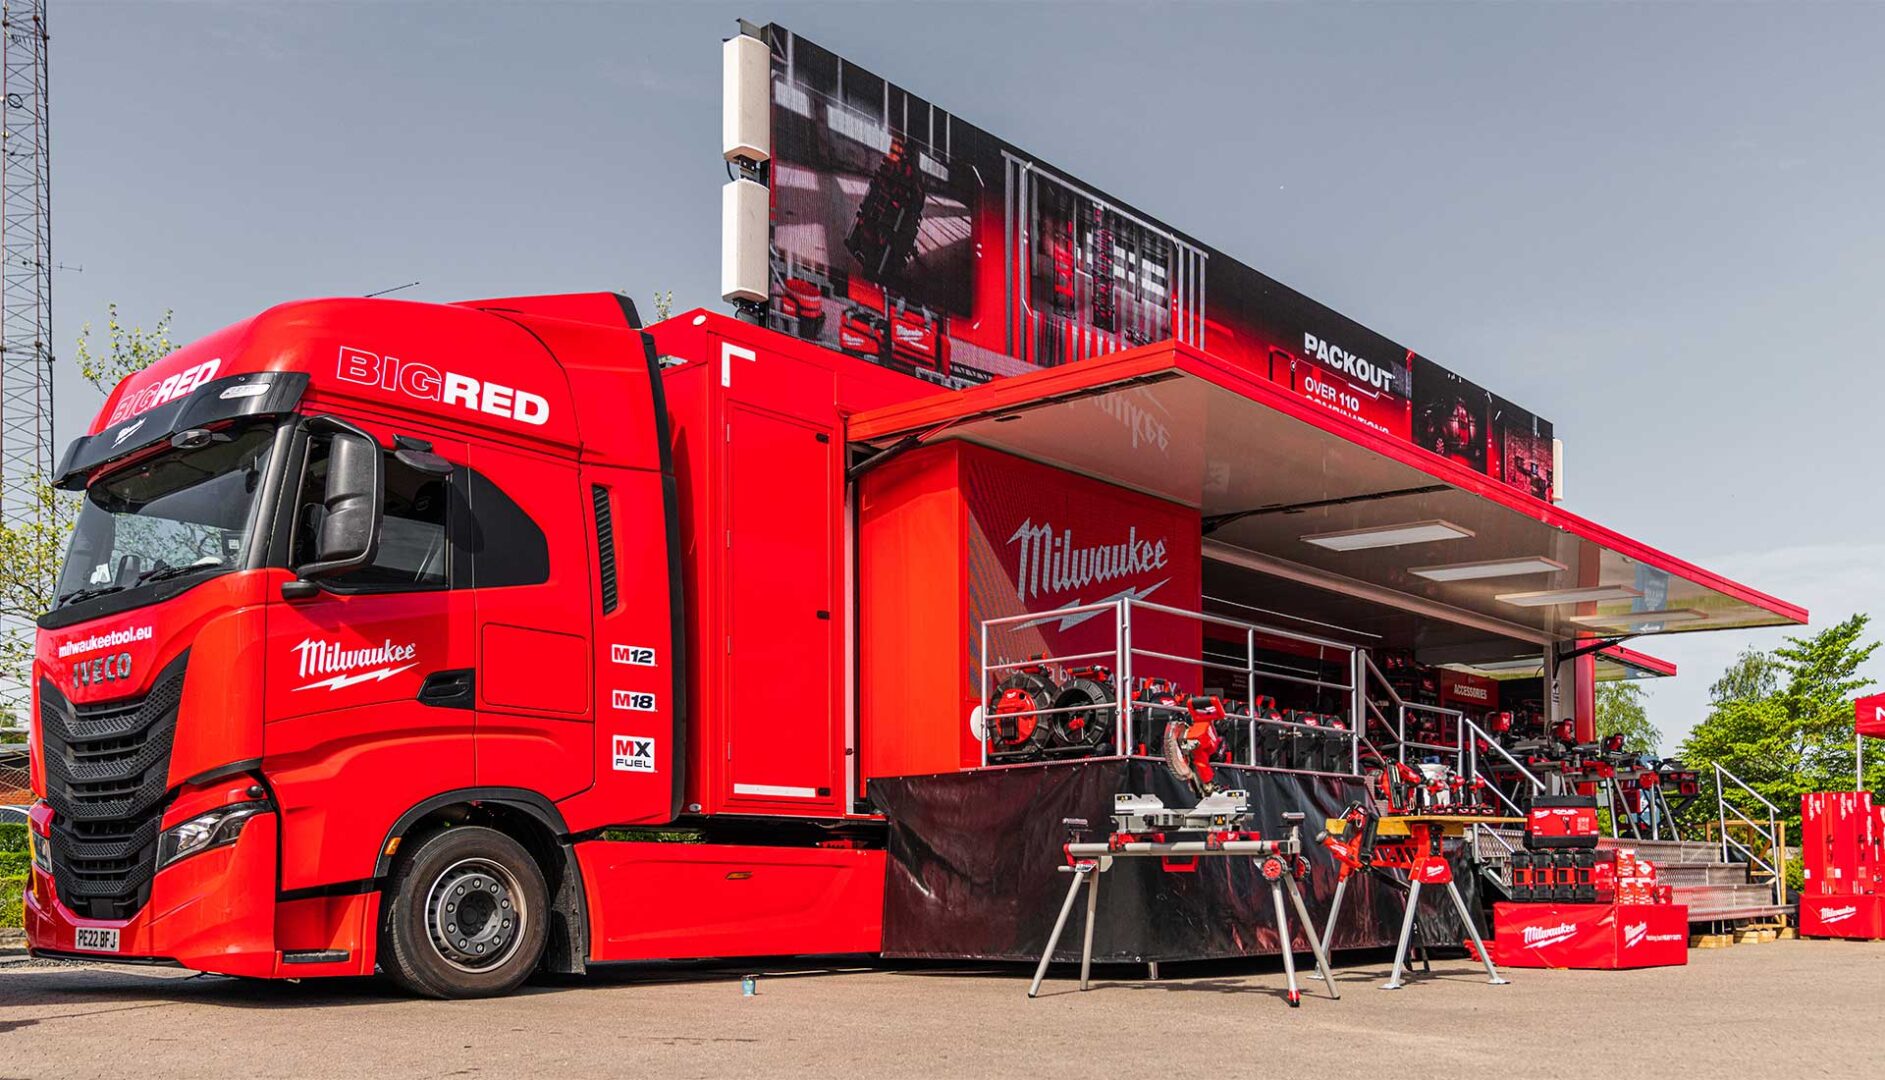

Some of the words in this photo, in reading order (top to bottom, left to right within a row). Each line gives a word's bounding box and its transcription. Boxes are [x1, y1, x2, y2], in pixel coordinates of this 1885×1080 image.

[1304, 332, 1394, 393] PACKOUT
[1304, 376, 1337, 402] OVER
[1339, 392, 1359, 412] 110
[1006, 517, 1168, 603] Milwaukee
[58, 626, 152, 659] milwaukeetool.eu
[290, 638, 416, 678] Milwaukee
[613, 646, 653, 664] M12
[73, 652, 132, 690] IVECO
[614, 692, 653, 709] M18
[1453, 683, 1488, 700] ACCESSORIES
[615, 739, 651, 758] MX
[615, 758, 652, 769] FUEL
[78, 929, 98, 948] PE22
[100, 931, 117, 949] BFJ
[1521, 922, 1577, 944] Milwaukee
